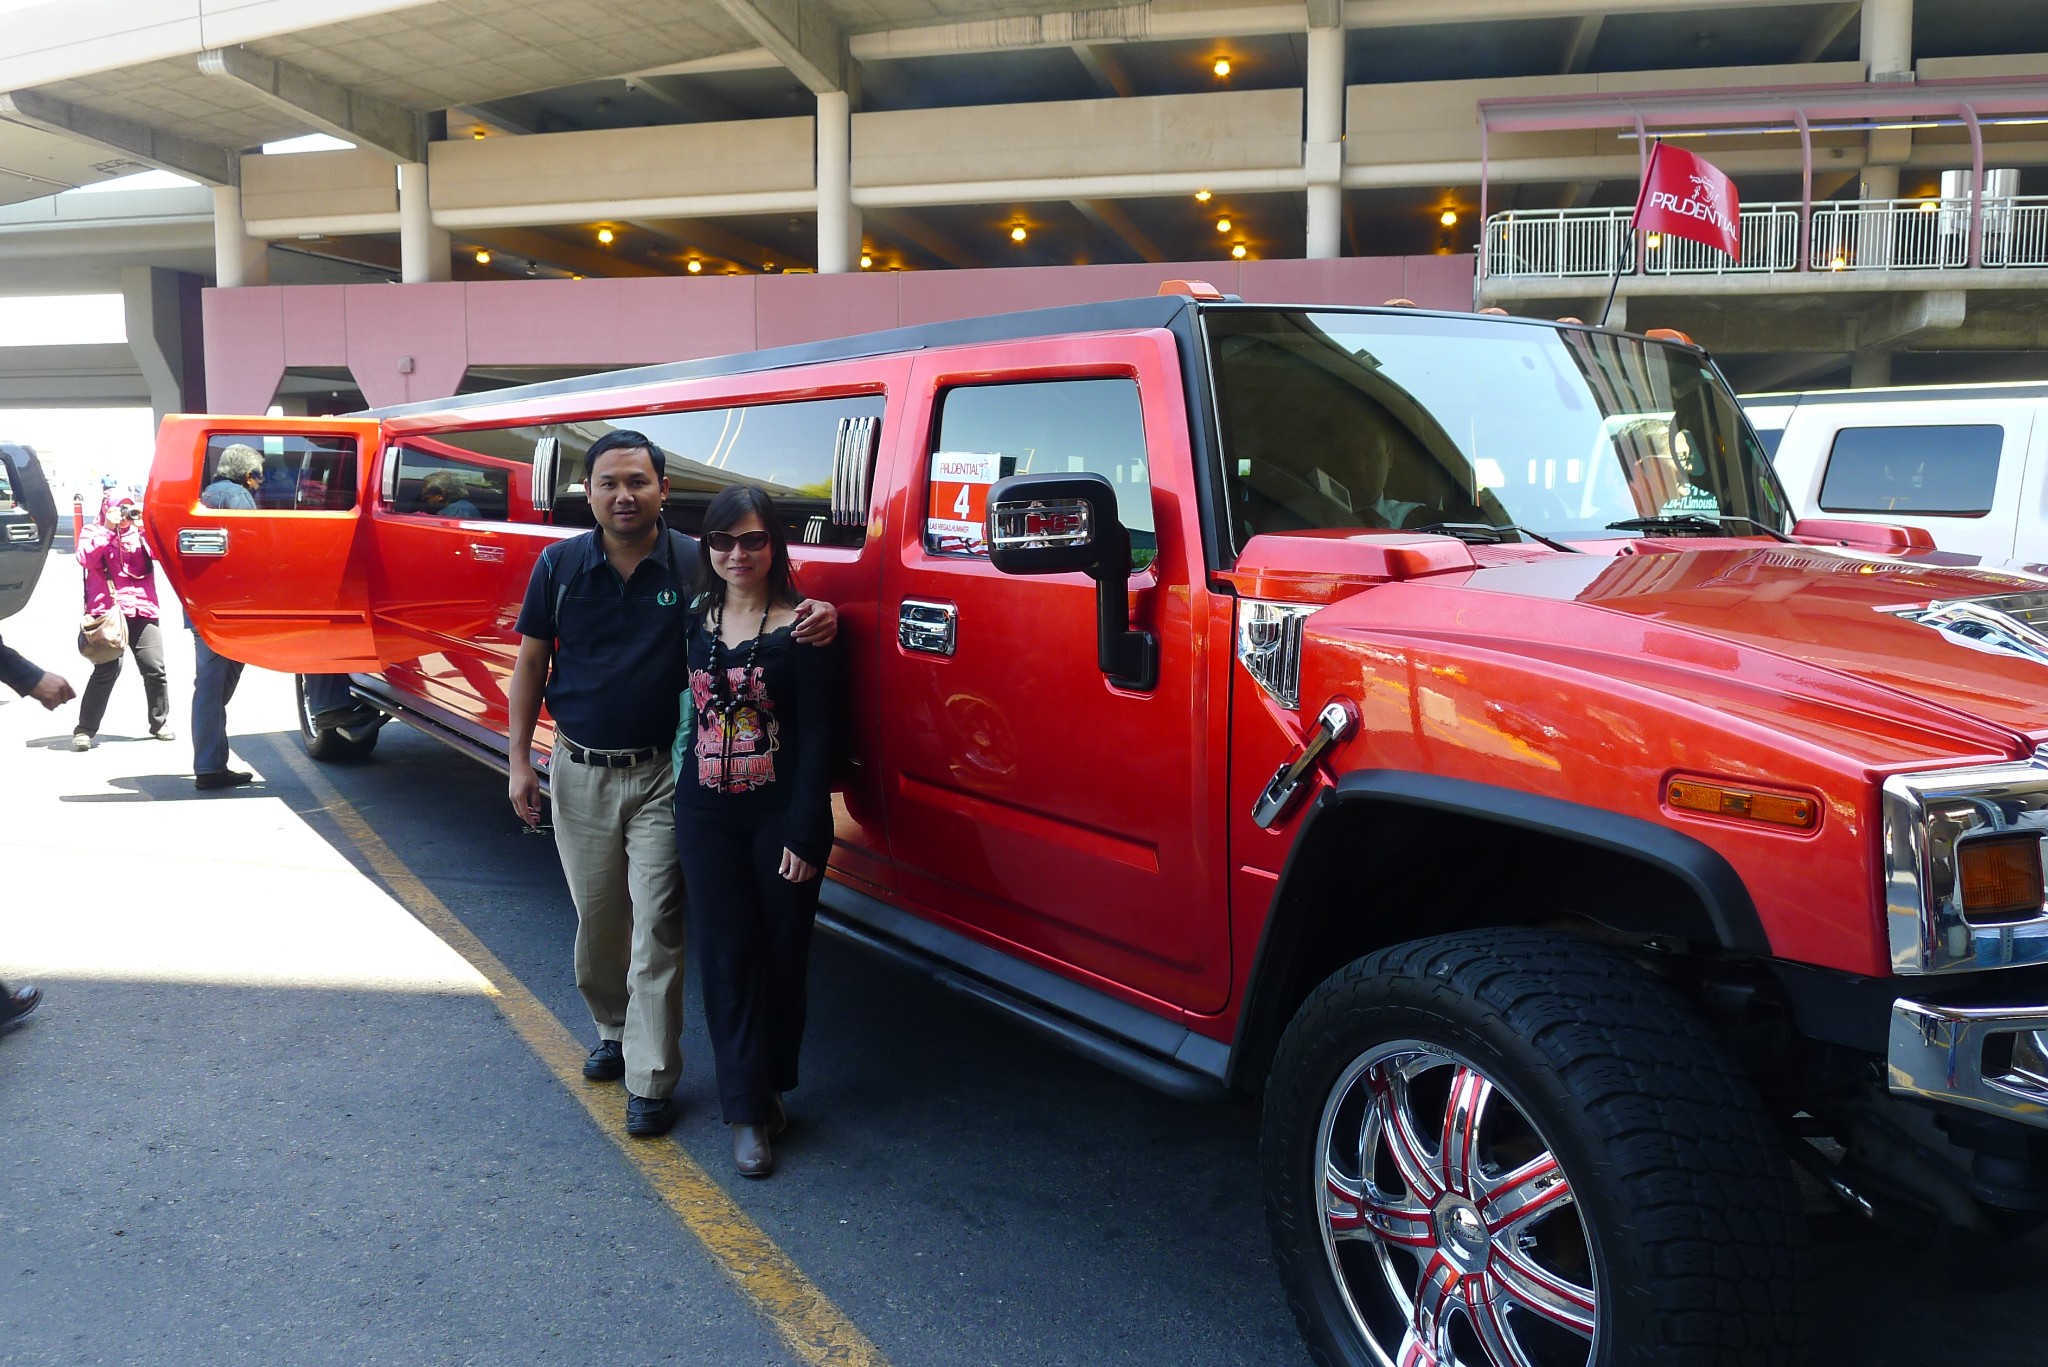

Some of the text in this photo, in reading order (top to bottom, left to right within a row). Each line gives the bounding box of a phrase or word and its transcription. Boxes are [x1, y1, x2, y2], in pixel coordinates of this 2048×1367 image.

[1649, 191, 1738, 242] PRUDENTIAL
[940, 462, 979, 476] PRUDENTIAL
[953, 484, 970, 520] 4
